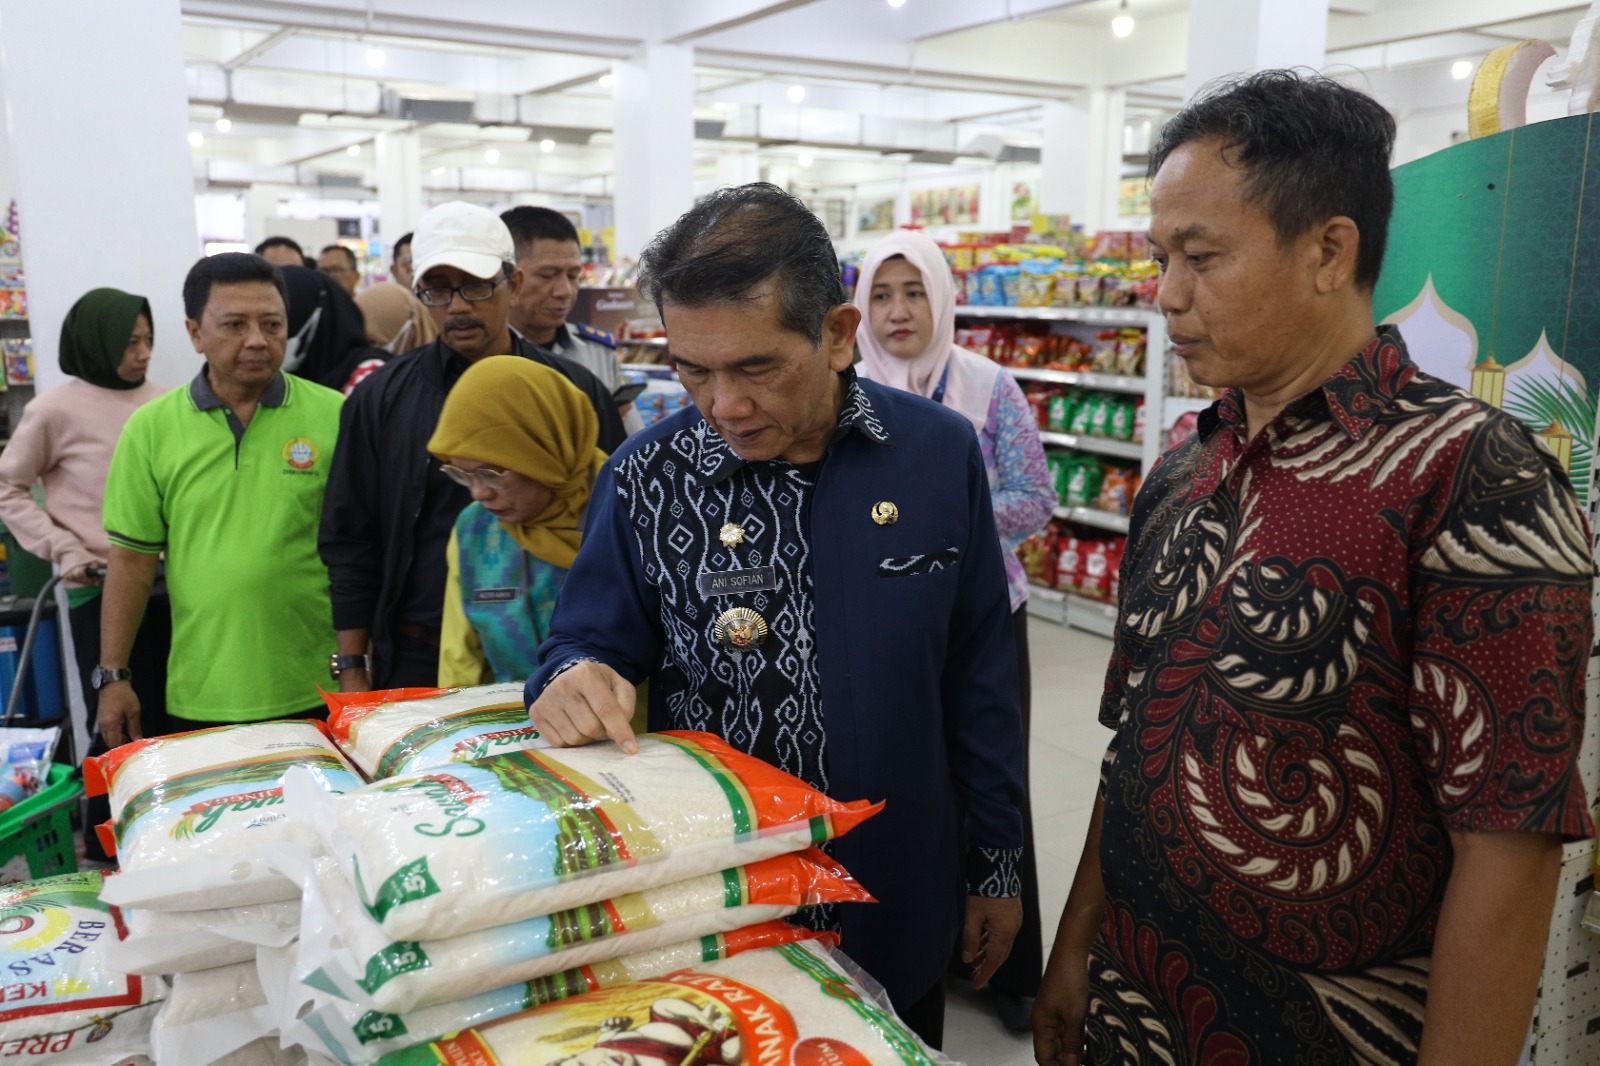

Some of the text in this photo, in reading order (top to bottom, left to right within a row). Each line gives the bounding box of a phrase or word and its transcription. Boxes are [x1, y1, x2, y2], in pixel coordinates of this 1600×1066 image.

[712, 574, 764, 589] ANI SOFIAN
[202, 789, 275, 808] JINGGA
[7, 920, 106, 977] BERAS
[0, 980, 47, 1003] KE
[0, 1031, 75, 1057] PRE
